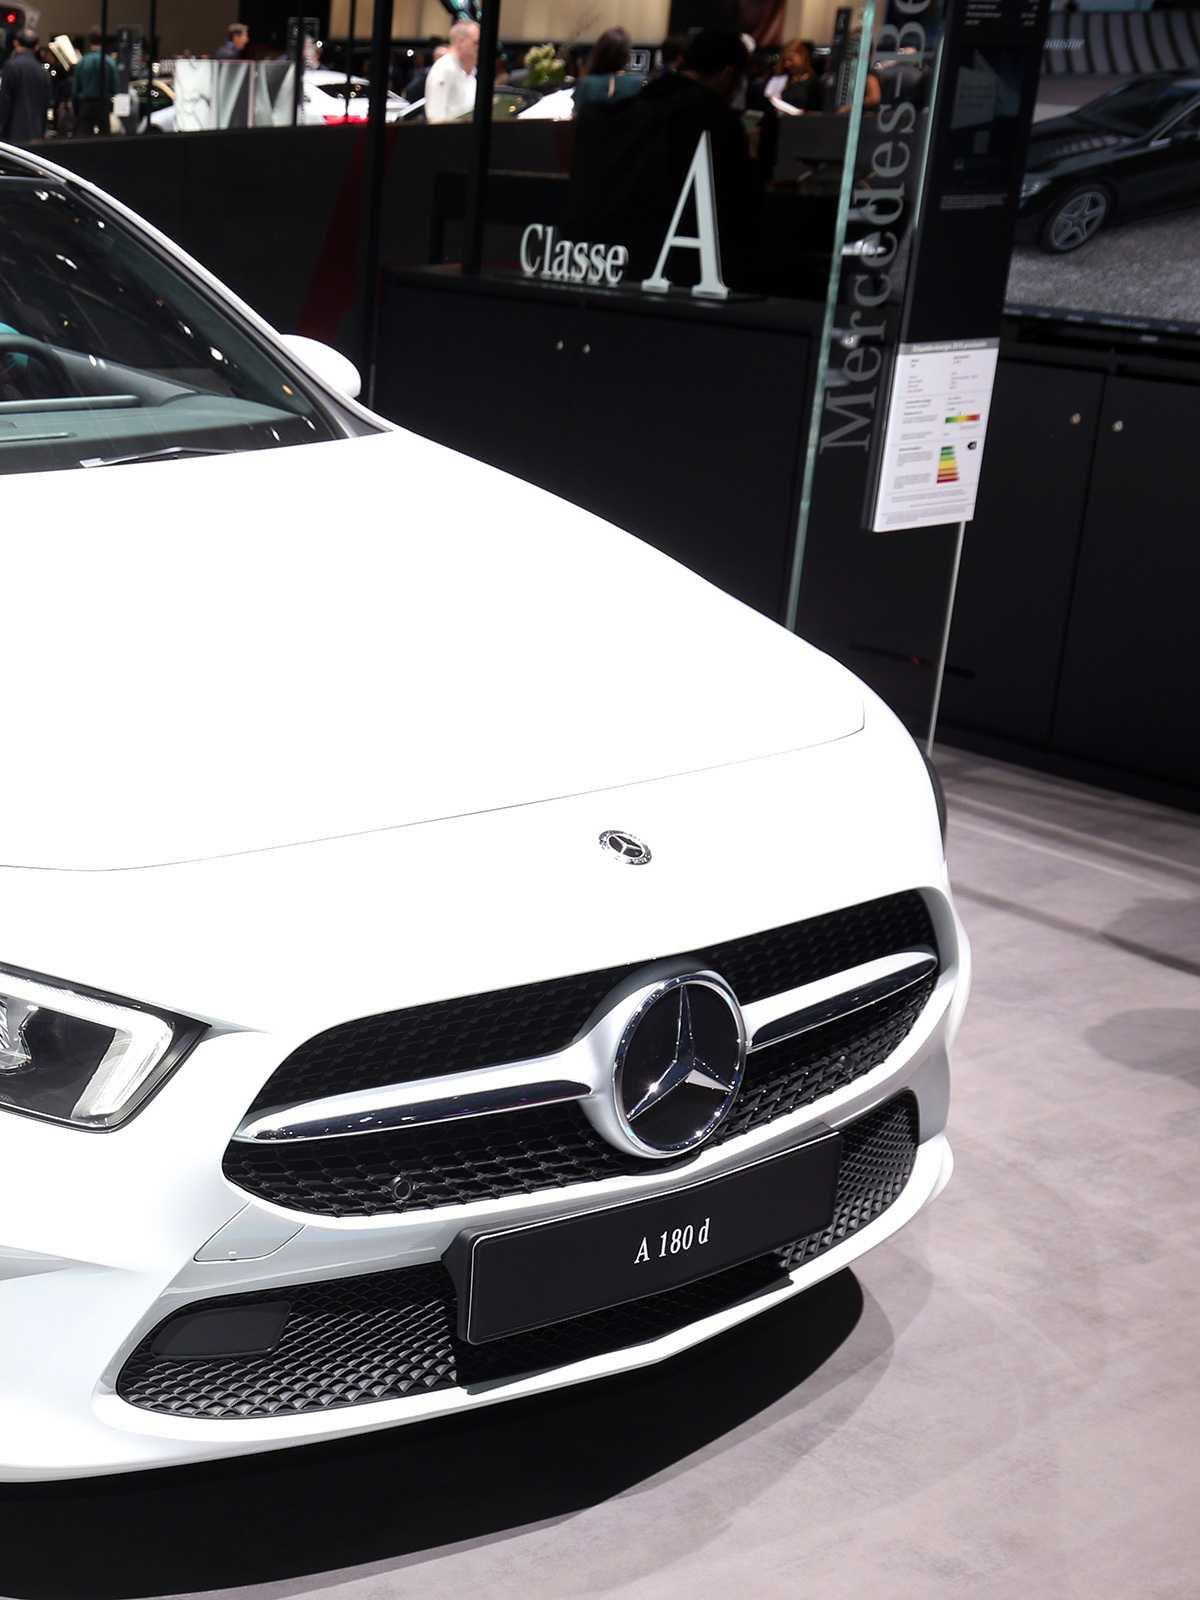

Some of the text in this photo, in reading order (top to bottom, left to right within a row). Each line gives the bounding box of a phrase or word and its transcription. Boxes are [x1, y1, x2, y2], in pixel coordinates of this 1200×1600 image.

[520, 129, 730, 299] Classe A
[633, 1217, 710, 1264] A 180 d
